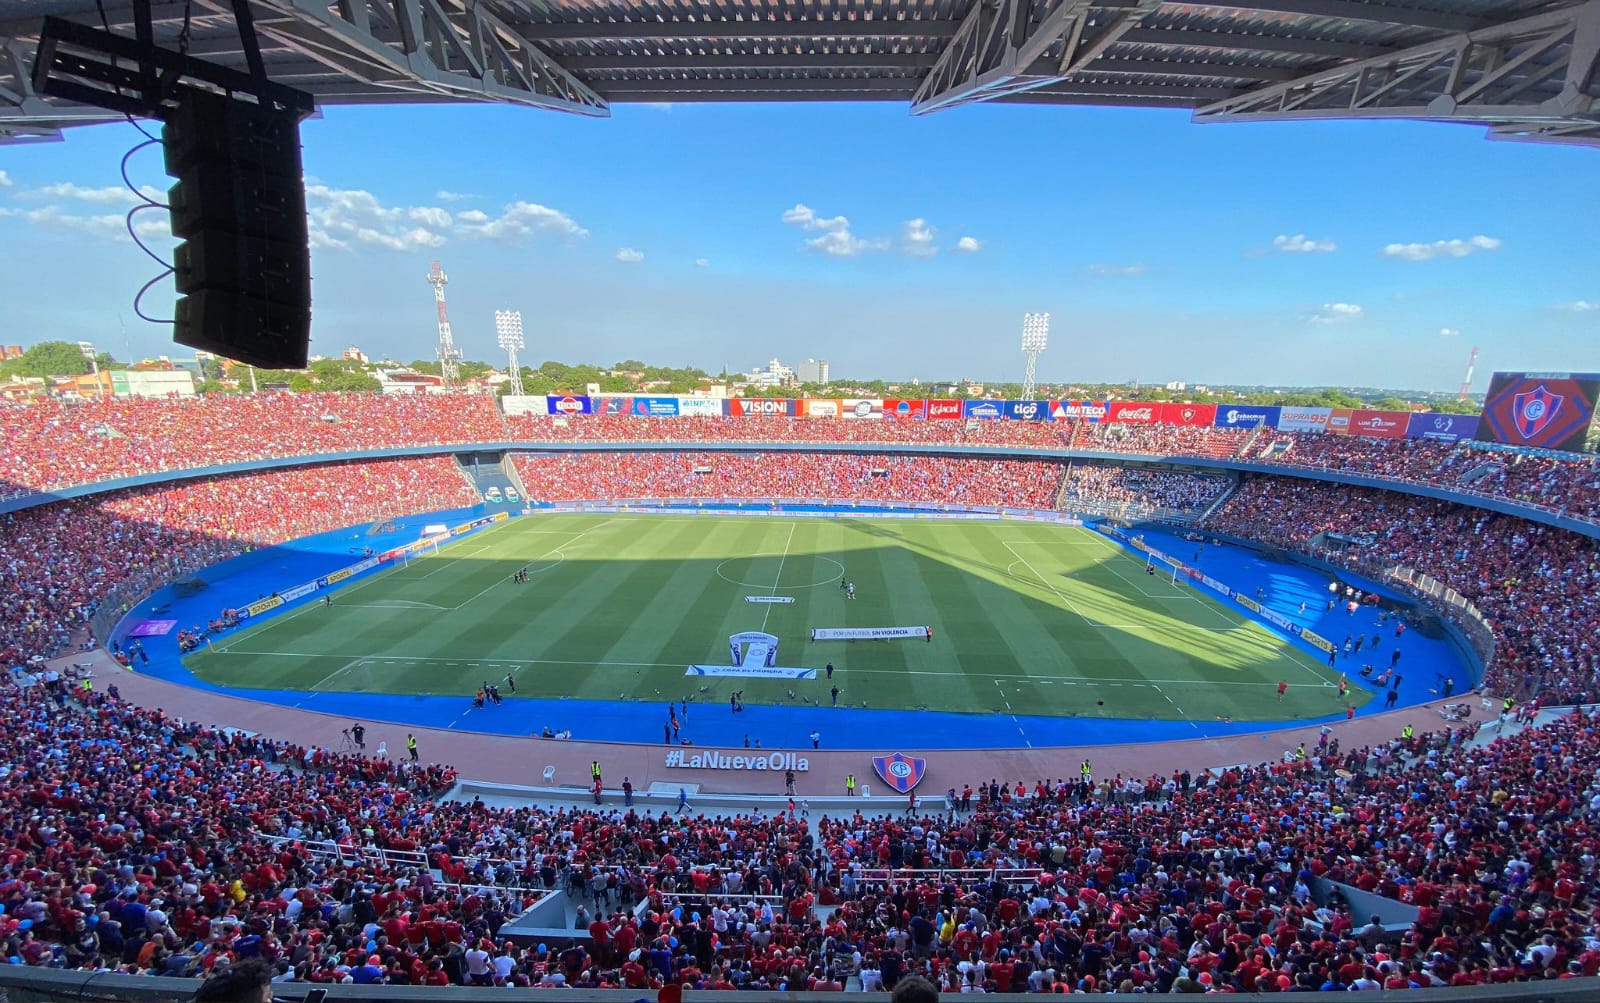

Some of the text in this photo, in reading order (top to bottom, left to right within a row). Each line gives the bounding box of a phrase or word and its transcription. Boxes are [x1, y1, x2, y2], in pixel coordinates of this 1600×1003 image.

[1014, 403, 1038, 419] tigo
[1066, 405, 1106, 415] MATECO
[1310, 414, 1328, 423] 95
[252, 599, 279, 614] SPORTS
[1303, 630, 1330, 650] SPORTS
[665, 750, 810, 772] #LaNuevaOlla
